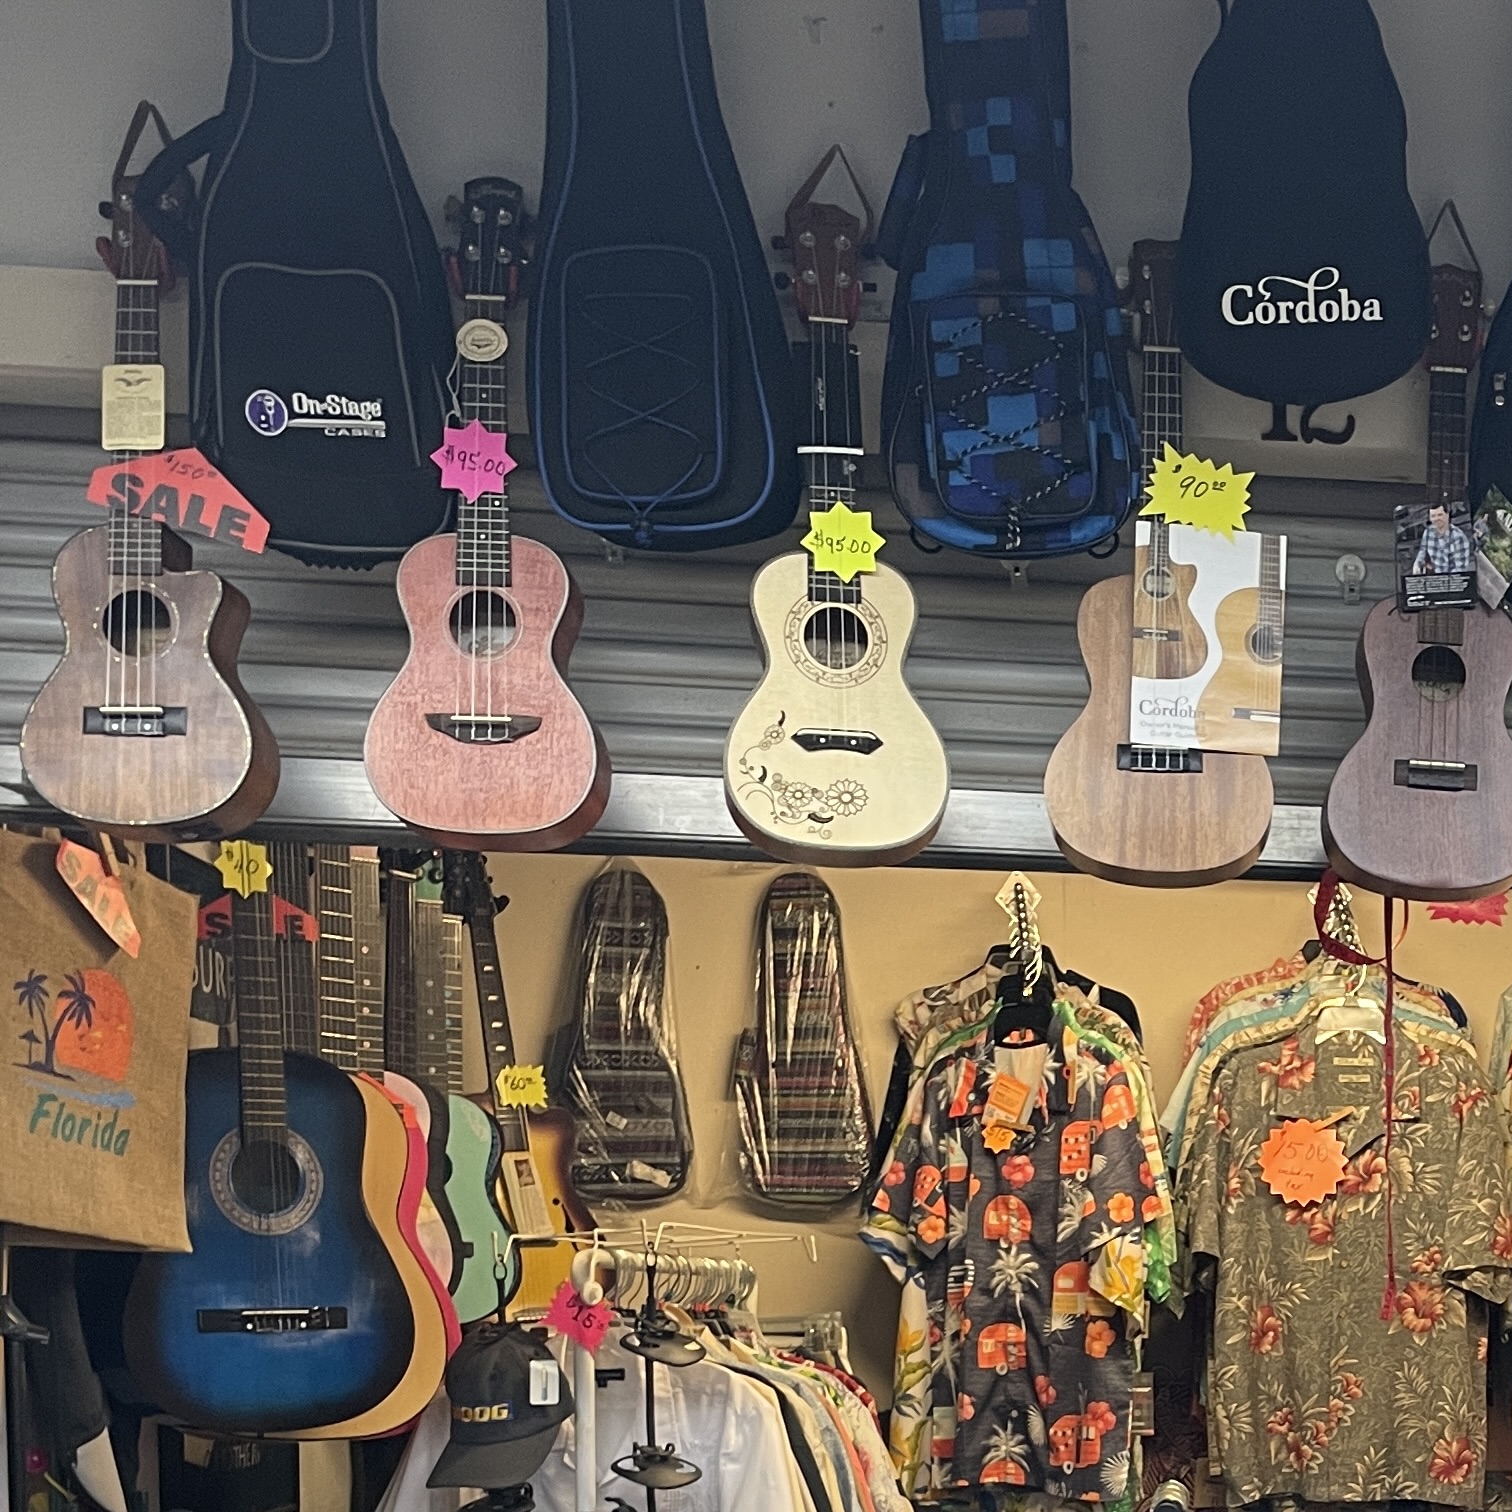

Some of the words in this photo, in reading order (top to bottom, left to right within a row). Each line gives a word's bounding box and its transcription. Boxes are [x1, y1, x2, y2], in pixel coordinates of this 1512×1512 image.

[291, 392, 382, 421] On-Stage
[443, 444, 506, 477] $95.00
[106, 472, 251, 549] SALE
[809, 529, 872, 554] $95.00
[29, 1093, 130, 1156] Florida
